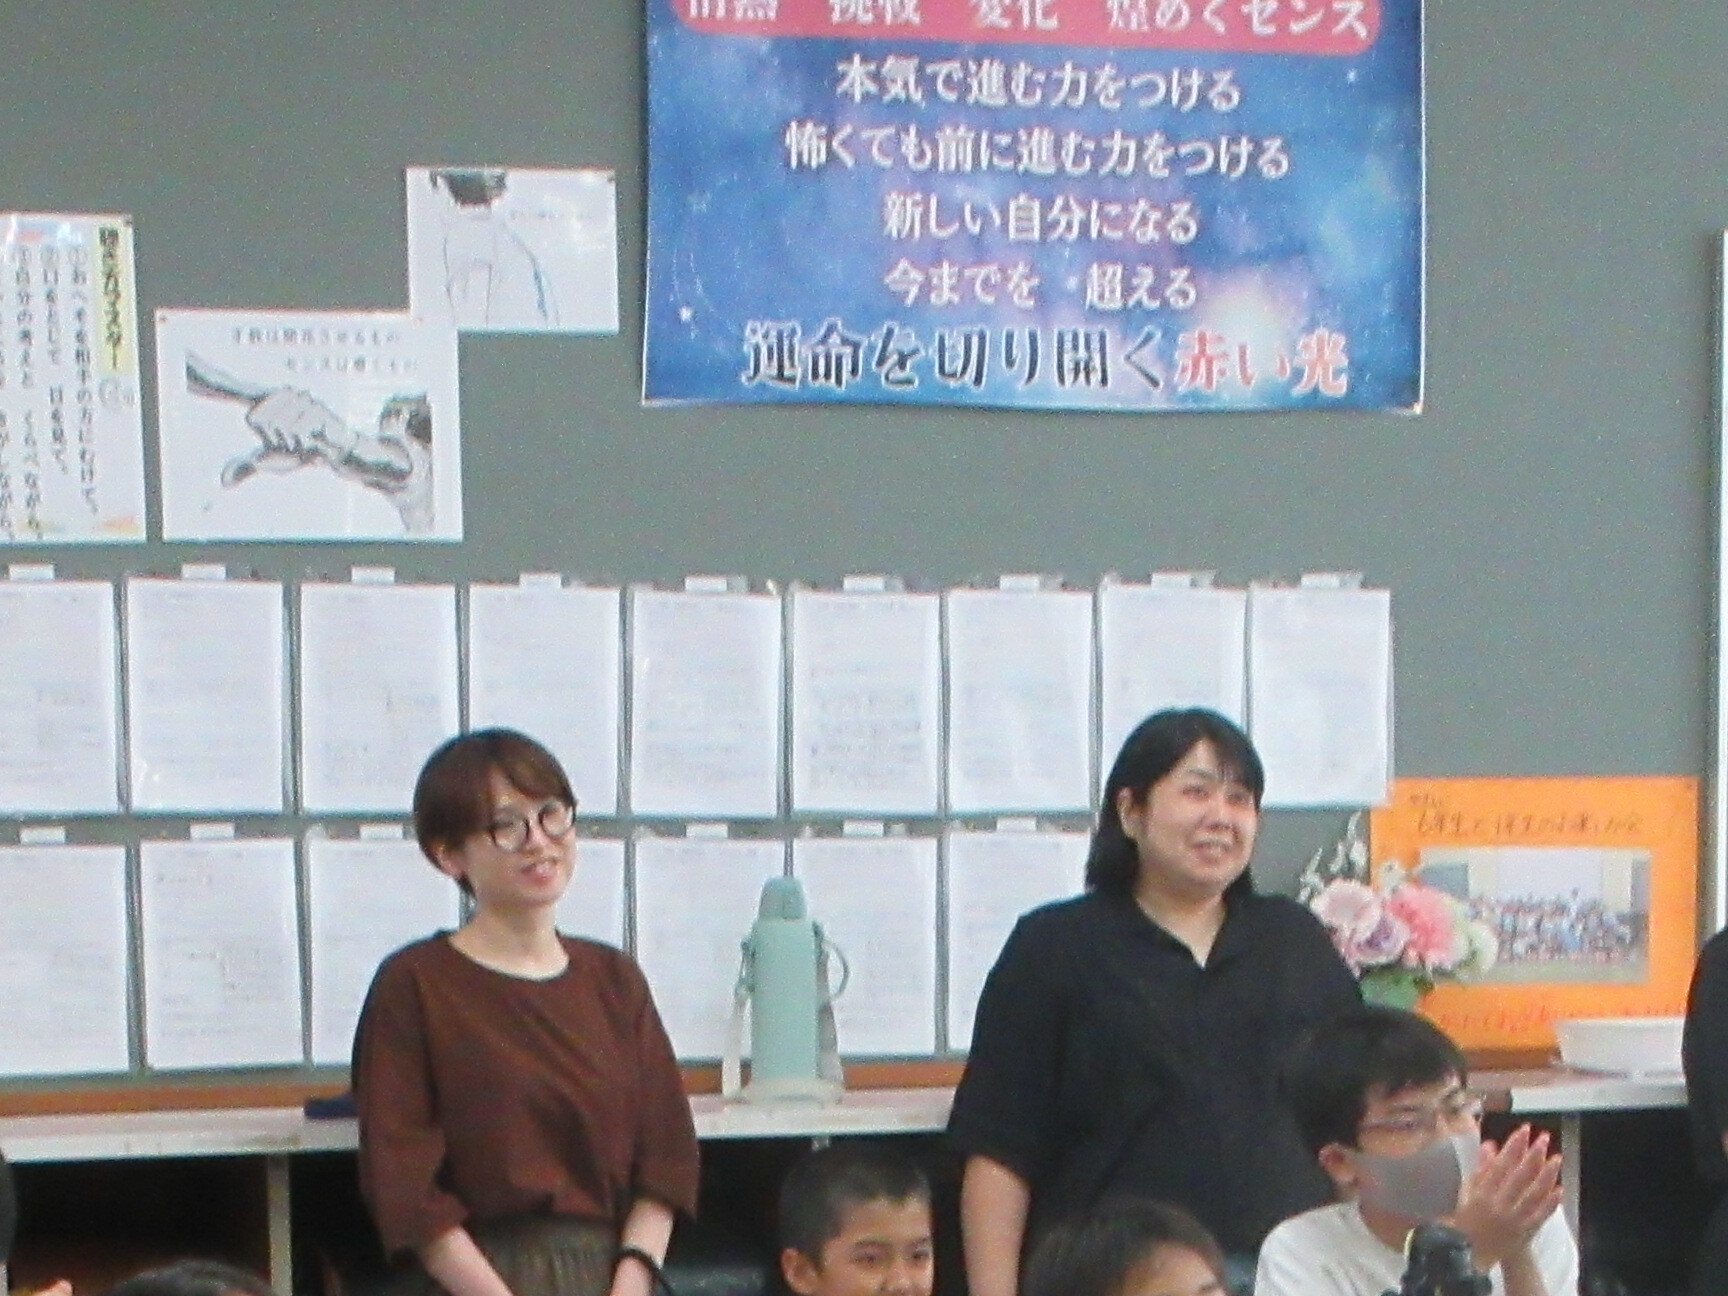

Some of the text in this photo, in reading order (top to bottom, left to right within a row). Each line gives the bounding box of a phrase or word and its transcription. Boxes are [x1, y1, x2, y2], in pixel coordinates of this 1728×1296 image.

[835, 52, 1242, 113] 本気で進む力をつける
[784, 118, 1292, 181] 怖くても前に進む力をつける
[882, 190, 1199, 245] 新しい自分になる
[883, 256, 1198, 313] 今までを 超える
[741, 319, 1349, 397] 運命を切り開く赤い光
